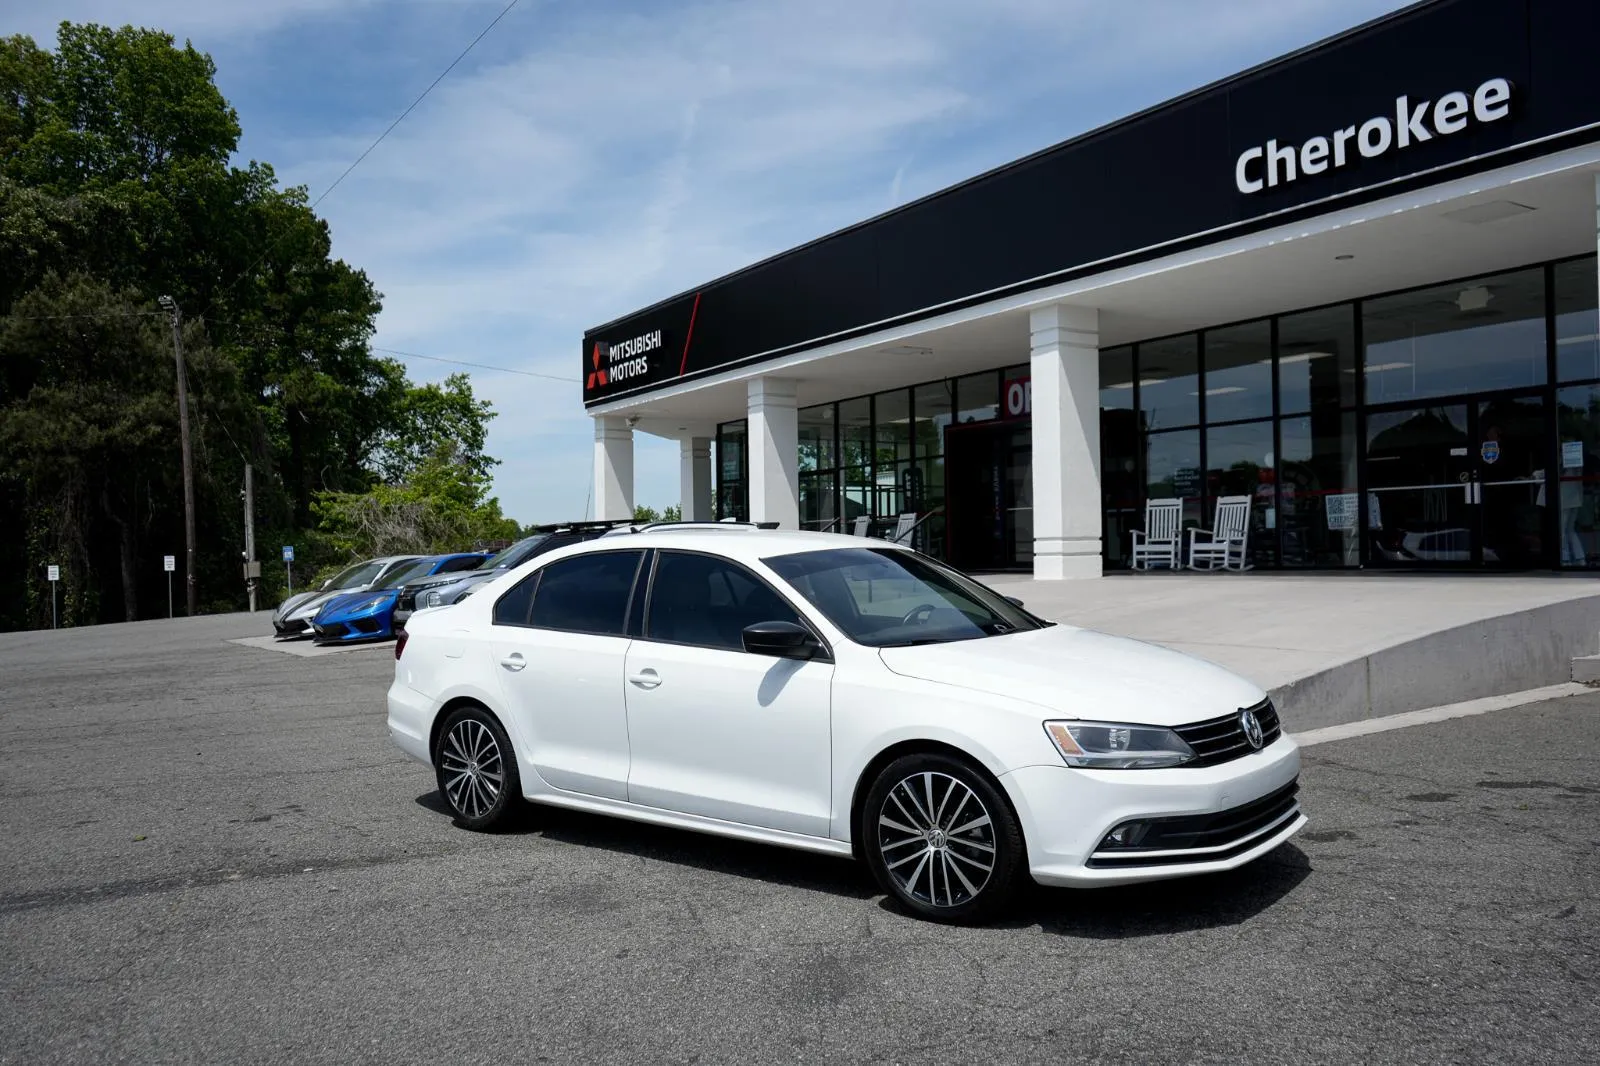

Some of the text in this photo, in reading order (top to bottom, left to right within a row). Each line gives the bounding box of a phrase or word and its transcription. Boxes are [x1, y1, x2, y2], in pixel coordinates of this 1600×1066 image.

[1235, 77, 1511, 194] Cherokee
[609, 330, 662, 362] MITSUBISHI
[609, 356, 648, 383] MOTORS
